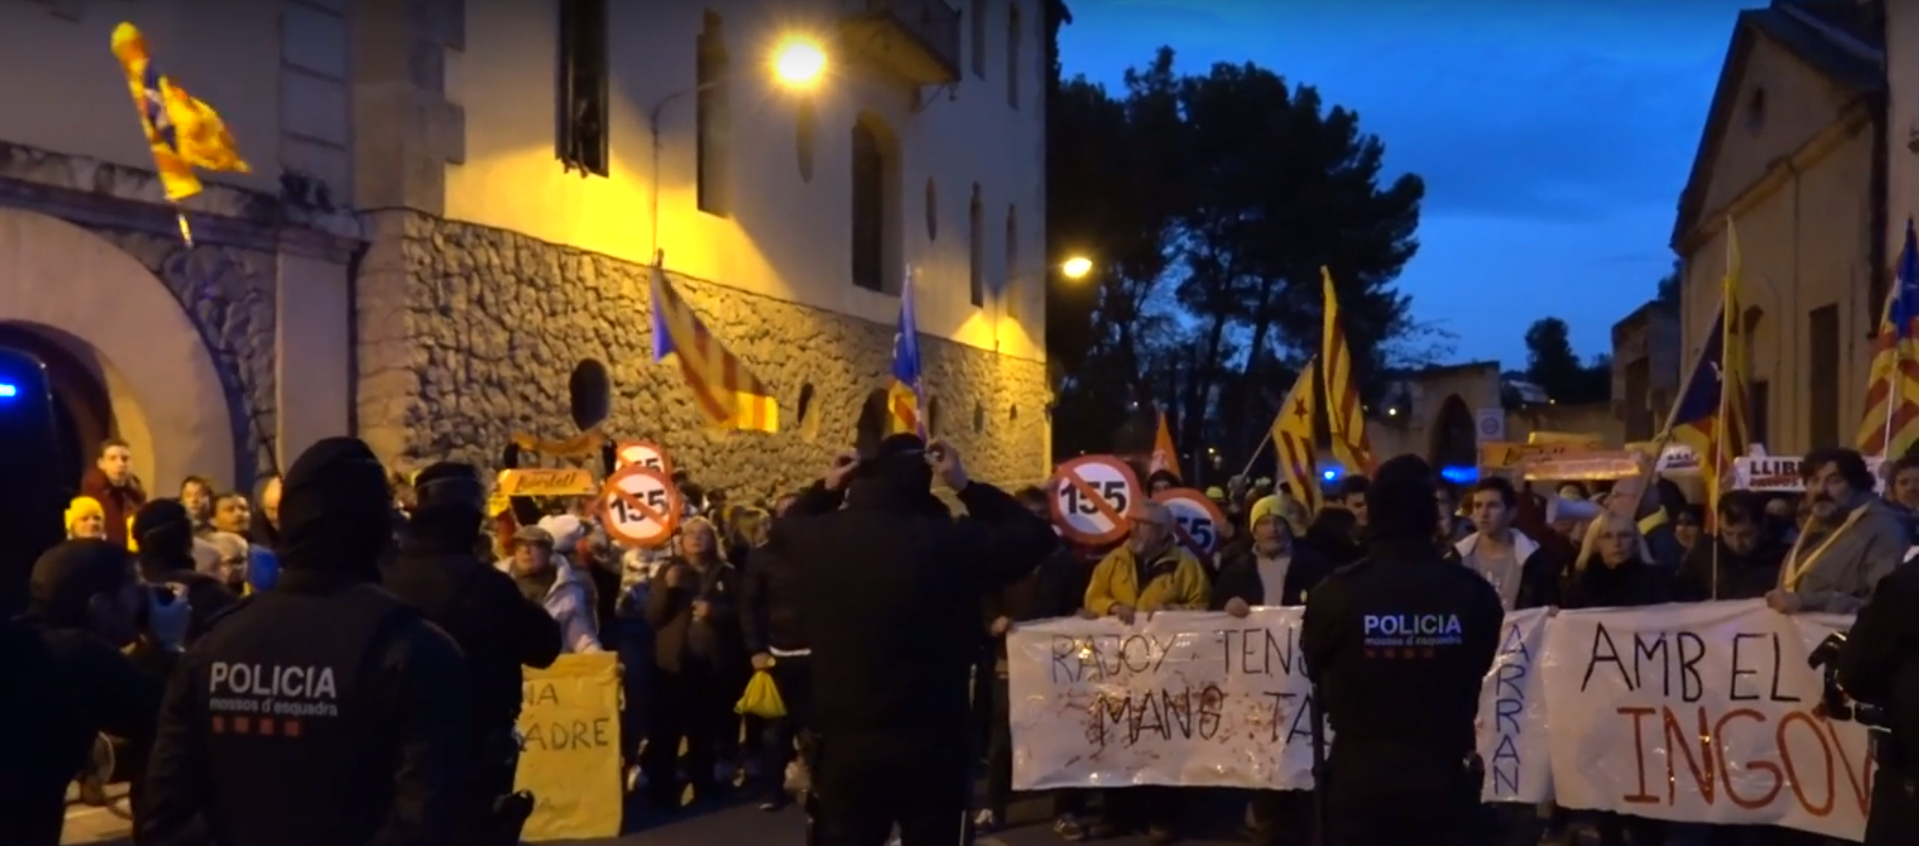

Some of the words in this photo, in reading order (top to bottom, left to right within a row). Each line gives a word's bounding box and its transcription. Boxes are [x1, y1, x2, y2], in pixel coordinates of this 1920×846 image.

[610, 489, 668, 524] 155
[1060, 481, 1127, 515] 155
[1363, 614, 1462, 635] POLICIA
[1051, 633, 1177, 684] RAJOY
[1581, 622, 1706, 703] AMB
[1729, 631, 1802, 702] EL
[209, 661, 337, 699] POLICIA
[209, 698, 259, 712] mossos
[1492, 623, 1531, 795] ARRAN
